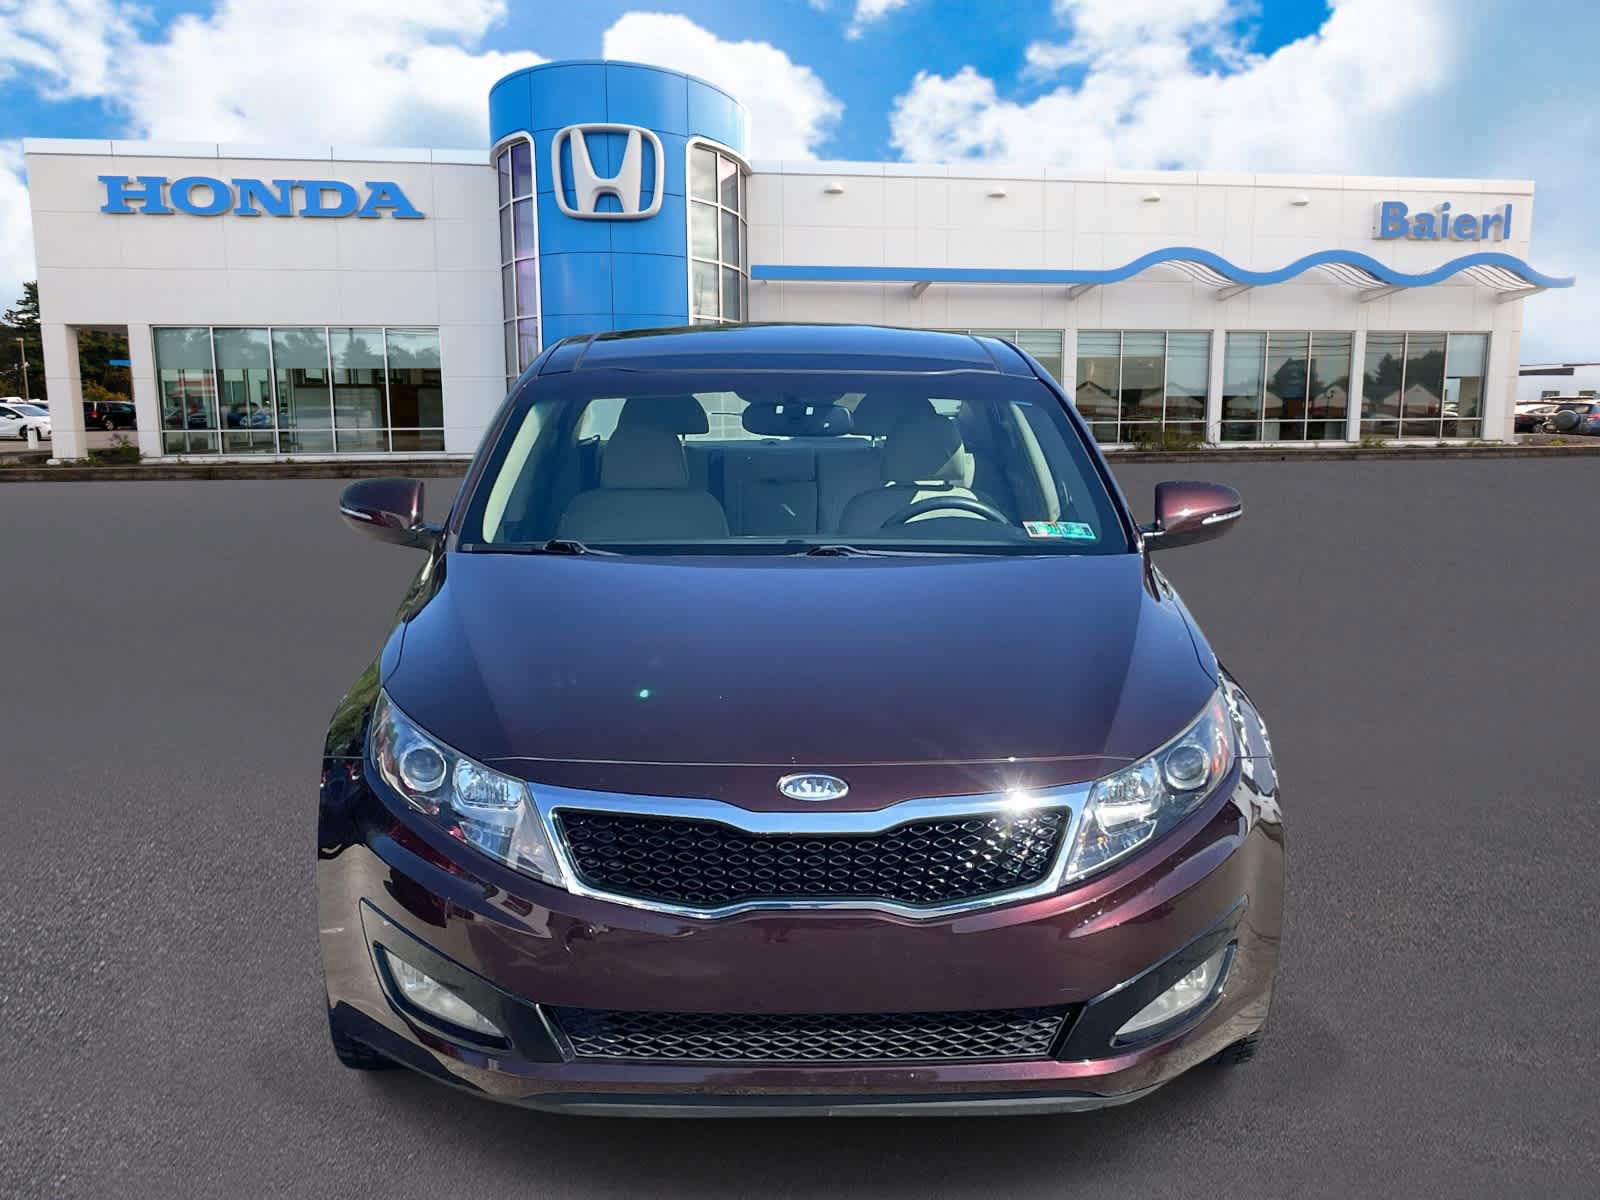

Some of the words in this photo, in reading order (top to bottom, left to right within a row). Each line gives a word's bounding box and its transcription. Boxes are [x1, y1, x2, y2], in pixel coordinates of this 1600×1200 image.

[98, 175, 424, 219] HONDA
[1379, 200, 1513, 240] Baierl
[789, 777, 838, 794] KIA
